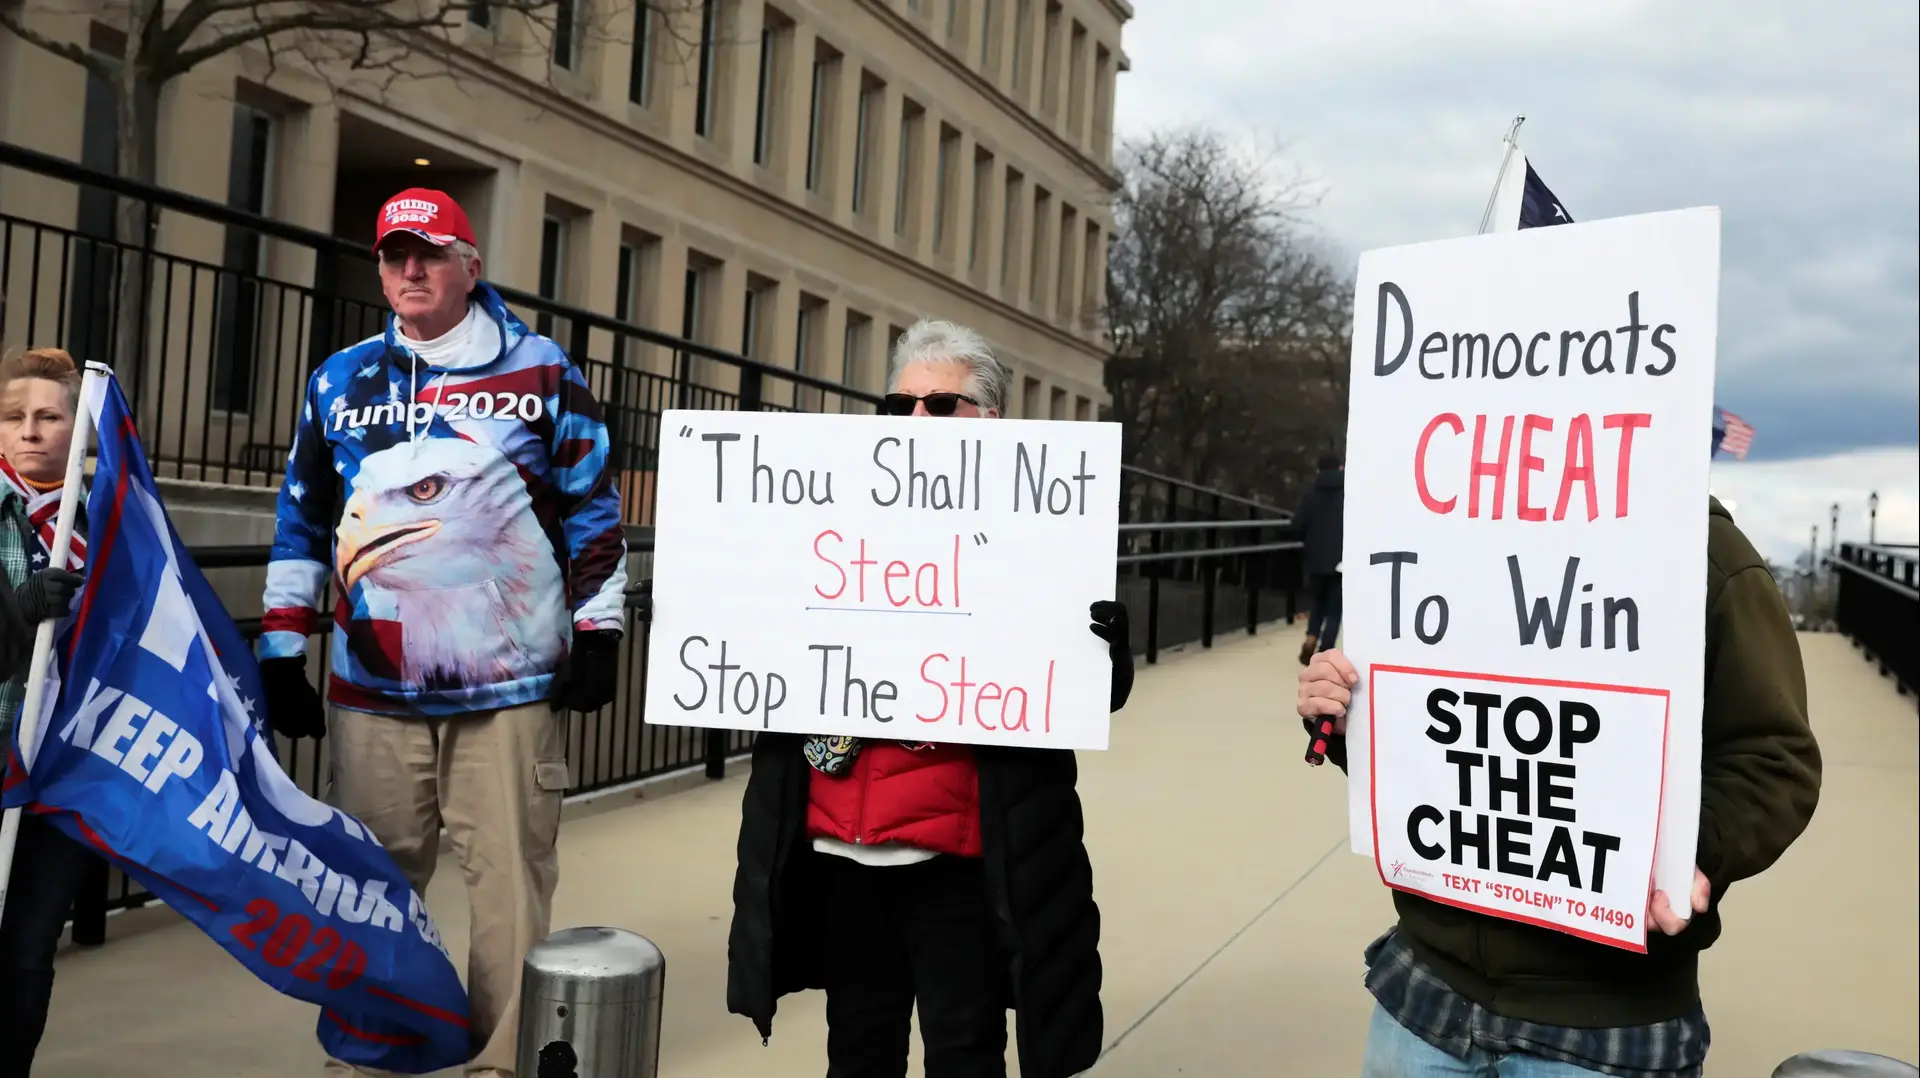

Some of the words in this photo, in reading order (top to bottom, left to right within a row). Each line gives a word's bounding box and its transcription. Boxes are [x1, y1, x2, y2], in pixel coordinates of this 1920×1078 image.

[385, 199, 439, 217] Trump
[1374, 281, 1677, 380] Democrats
[324, 400, 434, 434] rump
[444, 391, 543, 422] 2020
[871, 437, 981, 511] Shall
[1013, 442, 1096, 515] Not
[1414, 412, 1652, 522] CHEAT
[1370, 551, 1449, 645] To
[1507, 554, 1640, 652] Win
[673, 635, 787, 728] Stop
[808, 644, 898, 722] The
[916, 653, 1055, 733] Steal
[1425, 688, 1600, 759] STOP
[59, 677, 204, 794] KEEP
[1446, 749, 1576, 823] THE
[1407, 804, 1621, 894] CHEAT
[229, 897, 368, 991] 2020
[1442, 873, 1481, 893] TEXT
[1566, 899, 1587, 917] TO
[1590, 905, 1635, 929] 41490
